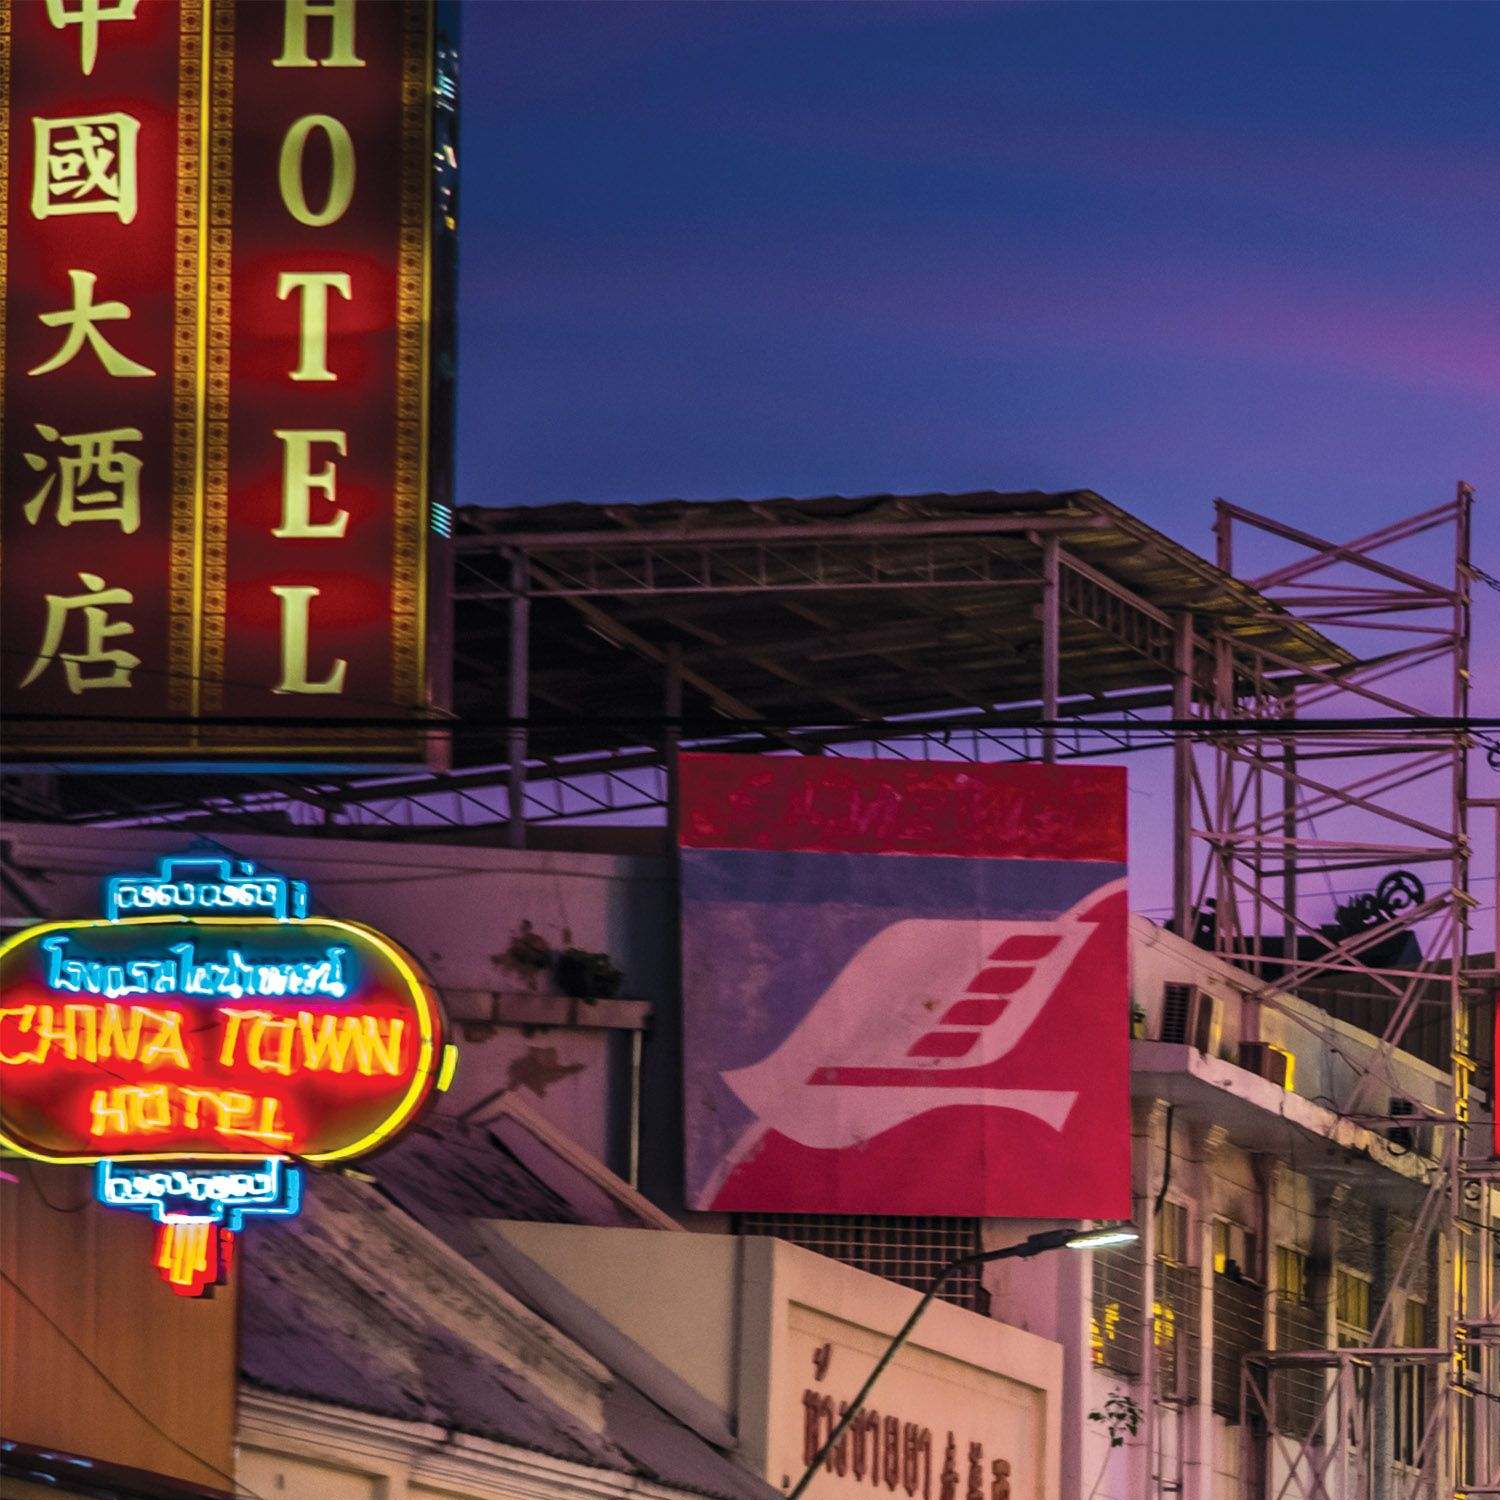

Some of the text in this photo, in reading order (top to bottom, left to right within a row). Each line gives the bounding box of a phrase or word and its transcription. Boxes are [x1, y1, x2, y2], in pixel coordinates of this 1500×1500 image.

[19, 0, 156, 695] 中國大酒店
[270, 0, 367, 695] HOTEL
[0, 1003, 404, 1077] CHINA TOWN
[90, 1085, 294, 1142] HOTEL
